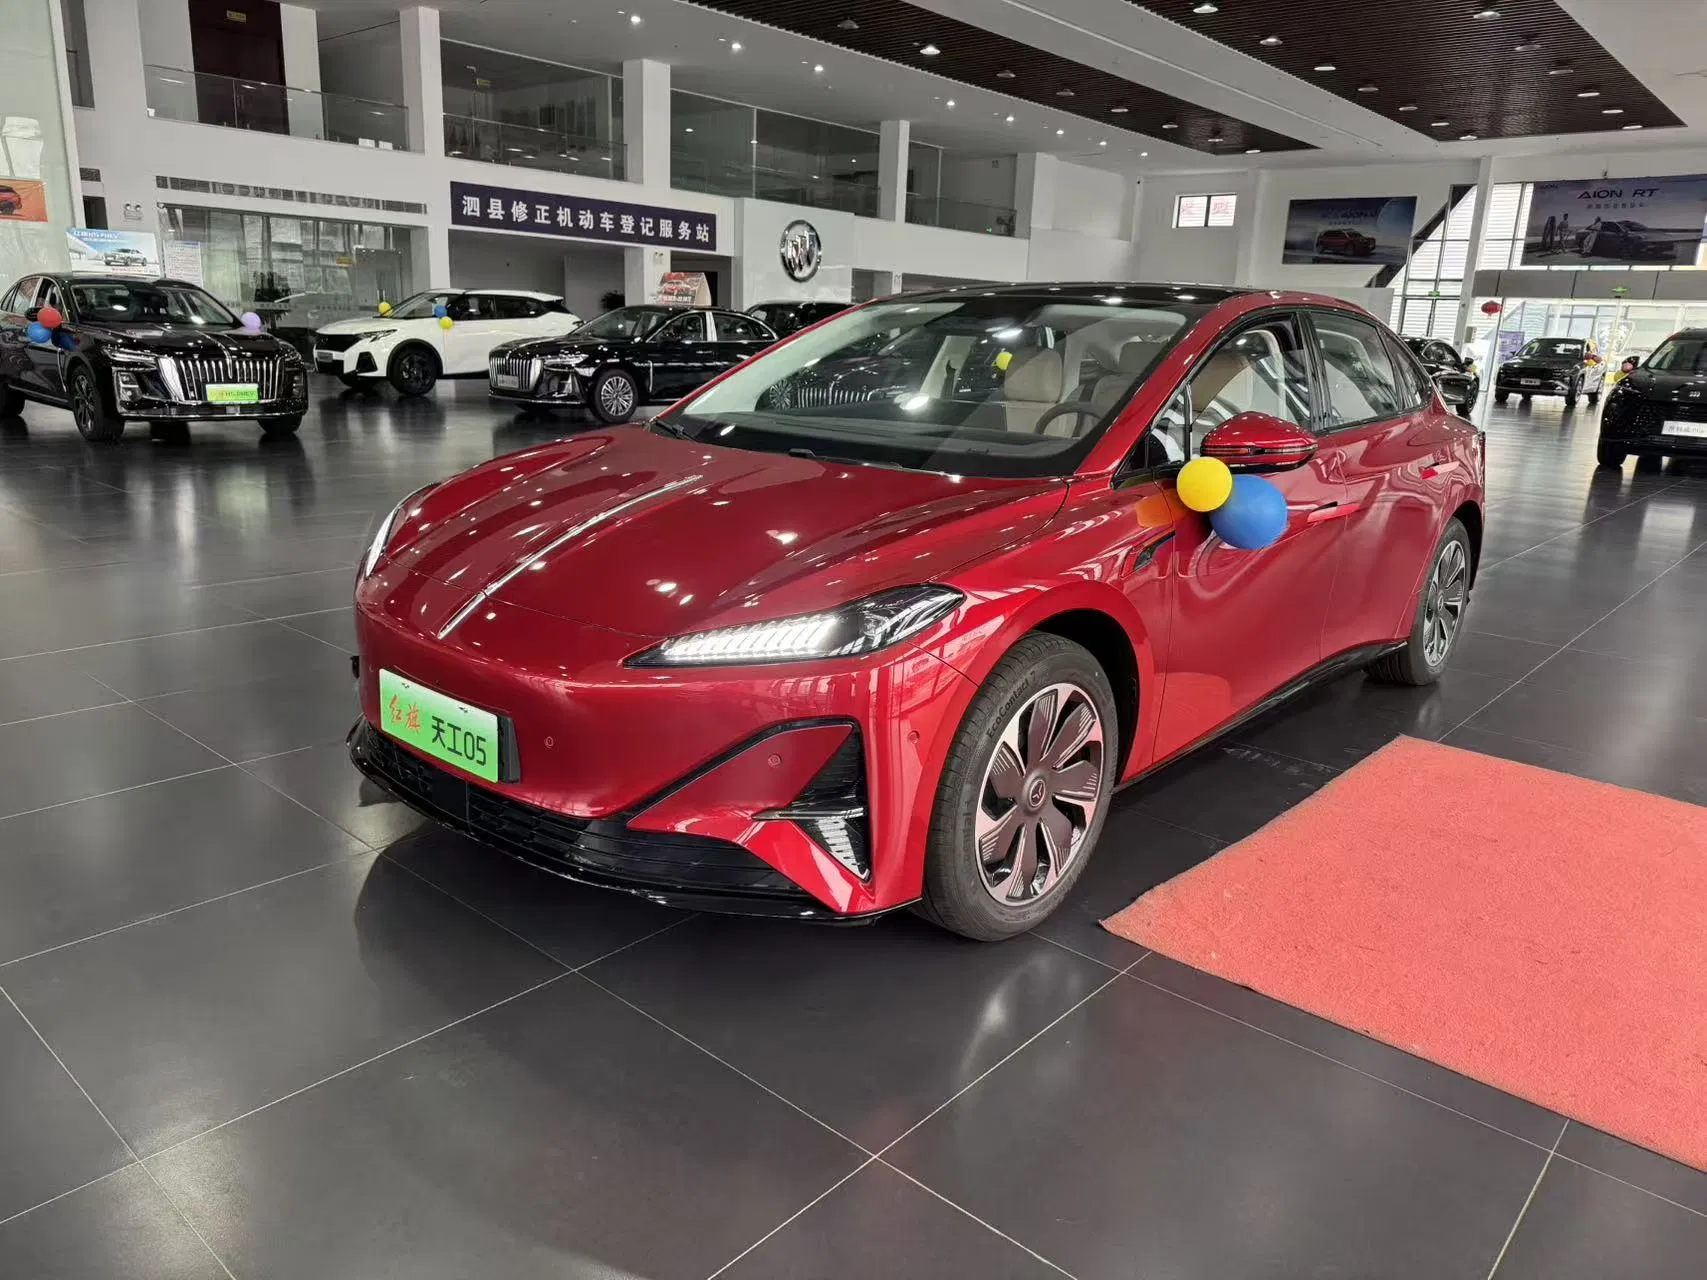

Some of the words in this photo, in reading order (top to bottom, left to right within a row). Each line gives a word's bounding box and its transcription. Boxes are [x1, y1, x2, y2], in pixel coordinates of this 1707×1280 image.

[462, 195, 709, 242] 泗县修正机动车登记服务站
[1577, 189, 1622, 200] AION
[1631, 188, 1660, 198] RT
[388, 695, 421, 734] 红旗
[431, 715, 487, 767] 天工05
[986, 678, 1029, 739] EcoContact
[1030, 670, 1036, 681] 7
